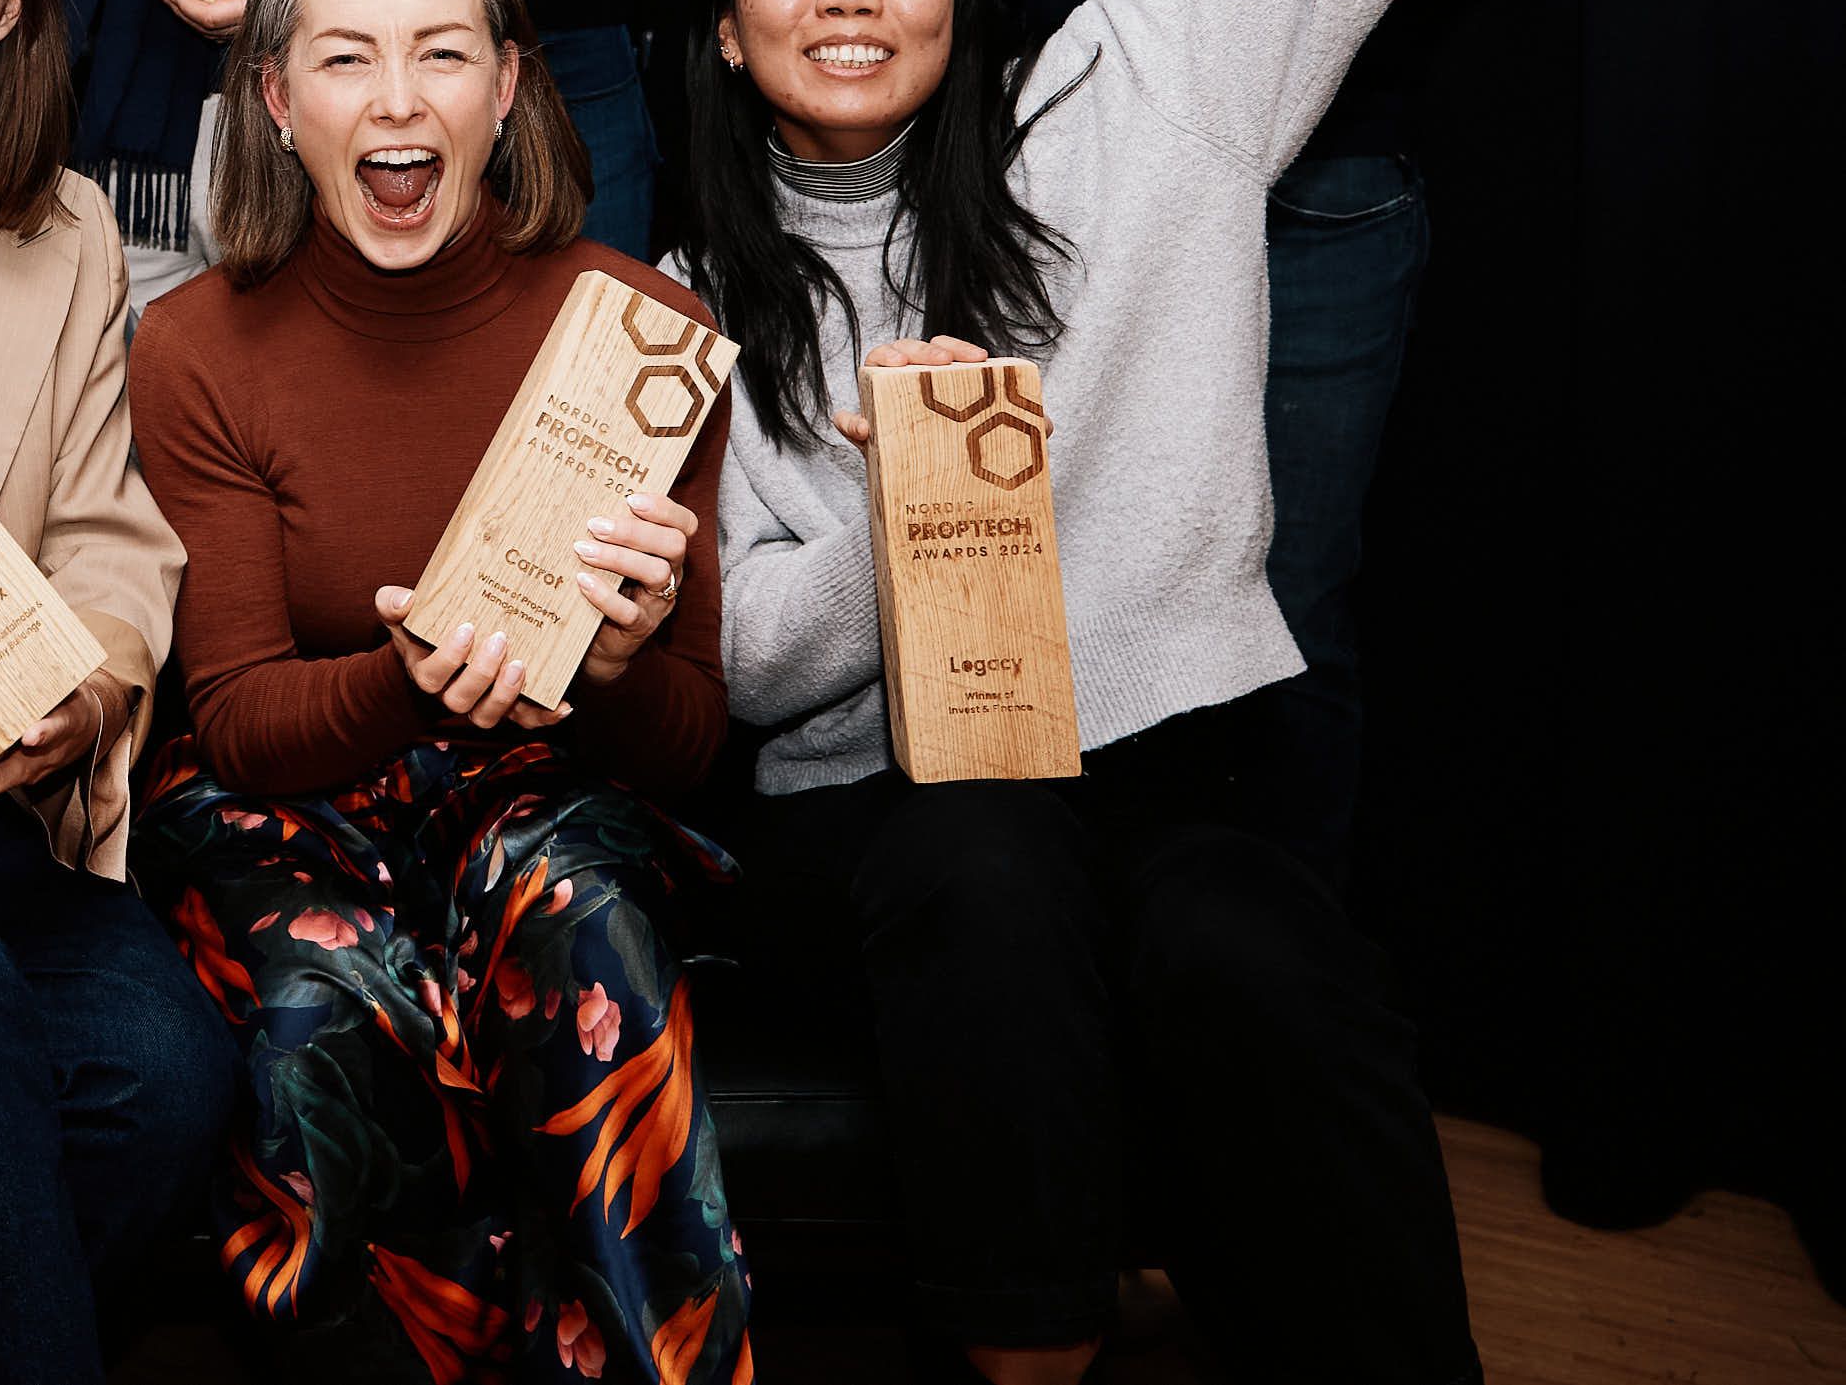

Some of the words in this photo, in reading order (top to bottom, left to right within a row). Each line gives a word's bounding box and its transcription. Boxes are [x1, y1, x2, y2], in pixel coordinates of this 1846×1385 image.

[547, 394, 610, 434] NORDIC
[528, 437, 596, 479] AWARDS
[535, 412, 650, 484] PROPTECH
[905, 501, 974, 515] NORDIC
[907, 517, 1033, 541] PROPTECH
[912, 546, 989, 561] AWARDS
[999, 543, 1042, 556] 2024
[505, 548, 564, 590] Carrot
[477, 571, 510, 594] Winner
[510, 591, 522, 601] of
[521, 596, 562, 624] Property
[481, 589, 544, 629] Management
[9, 619, 42, 650] Buildings
[950, 656, 1023, 680] Legacy
[949, 705, 981, 715] Invest
[982, 705, 990, 713] &
[993, 703, 1034, 713] Finance
[965, 691, 1002, 701] Winner
